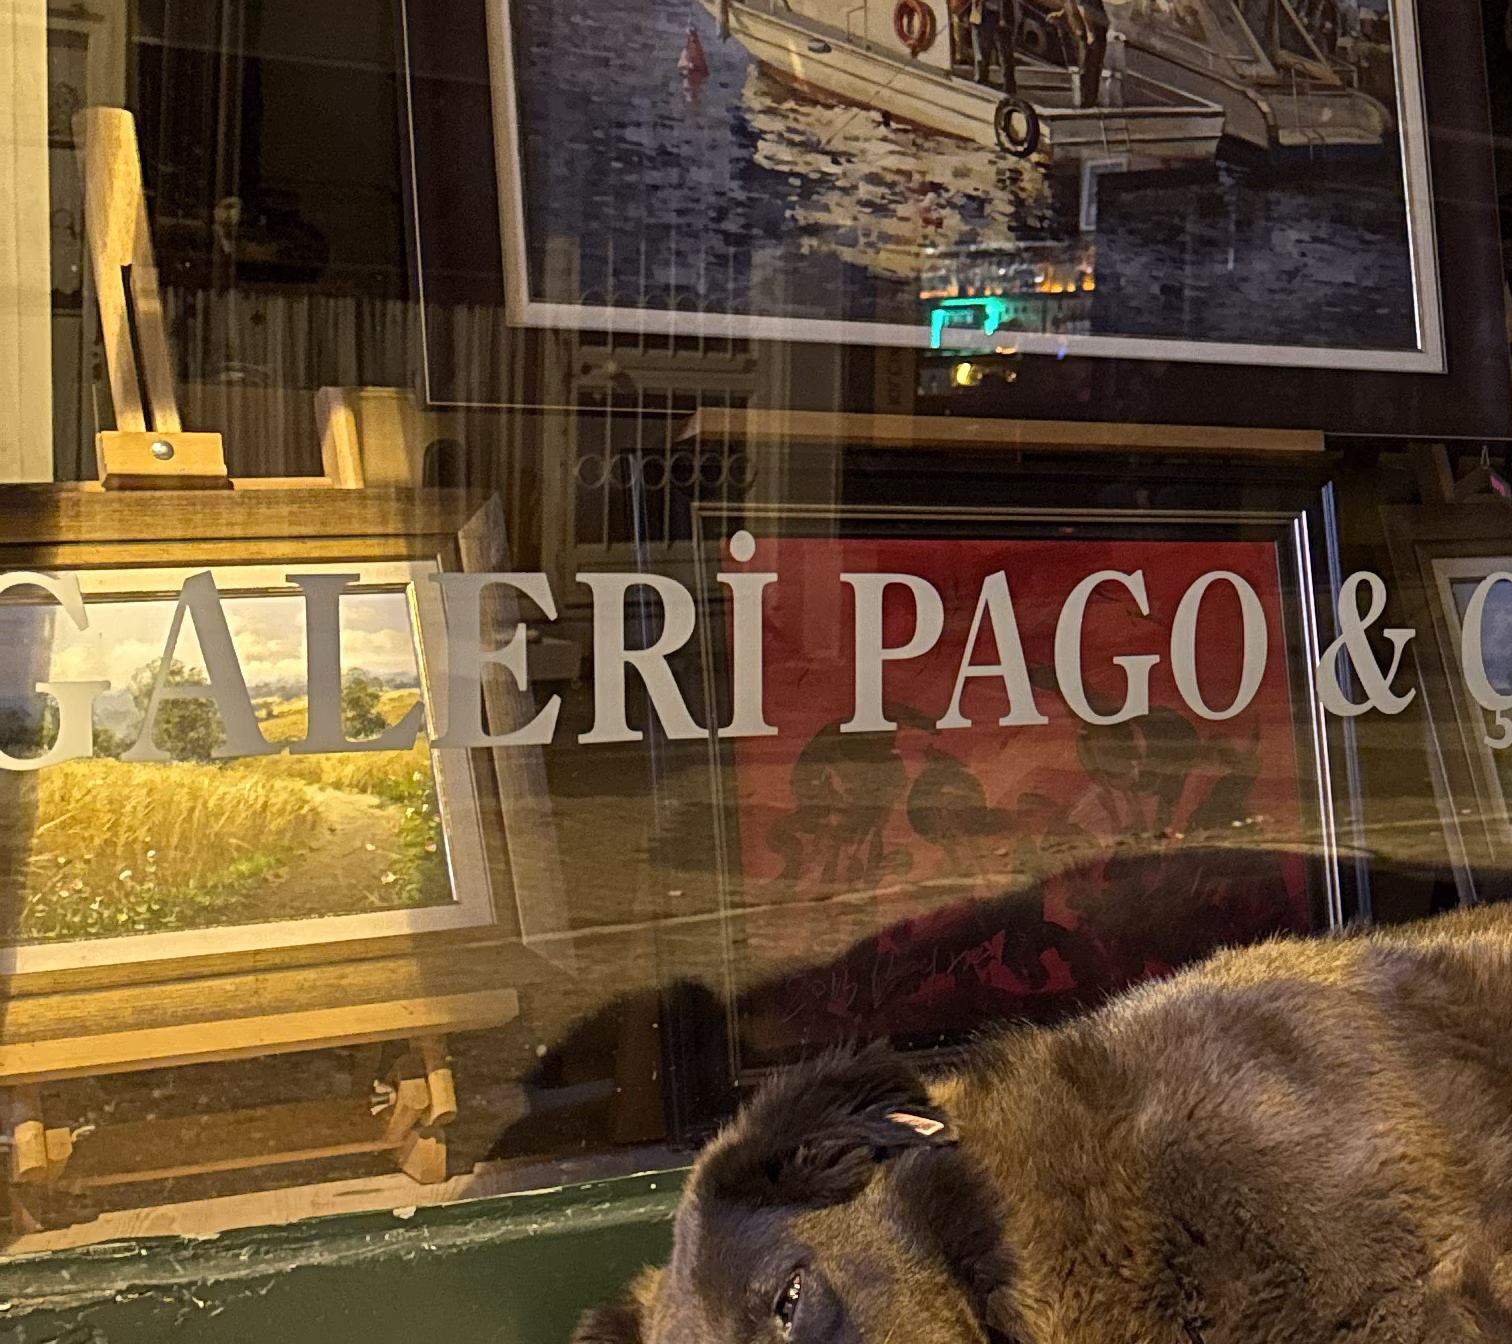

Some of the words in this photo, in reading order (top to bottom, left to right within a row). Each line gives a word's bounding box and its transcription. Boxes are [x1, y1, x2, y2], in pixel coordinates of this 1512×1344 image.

[0, 528, 780, 773] GALERİ
[838, 567, 1270, 735] PAGO
[1315, 569, 1417, 718] &
